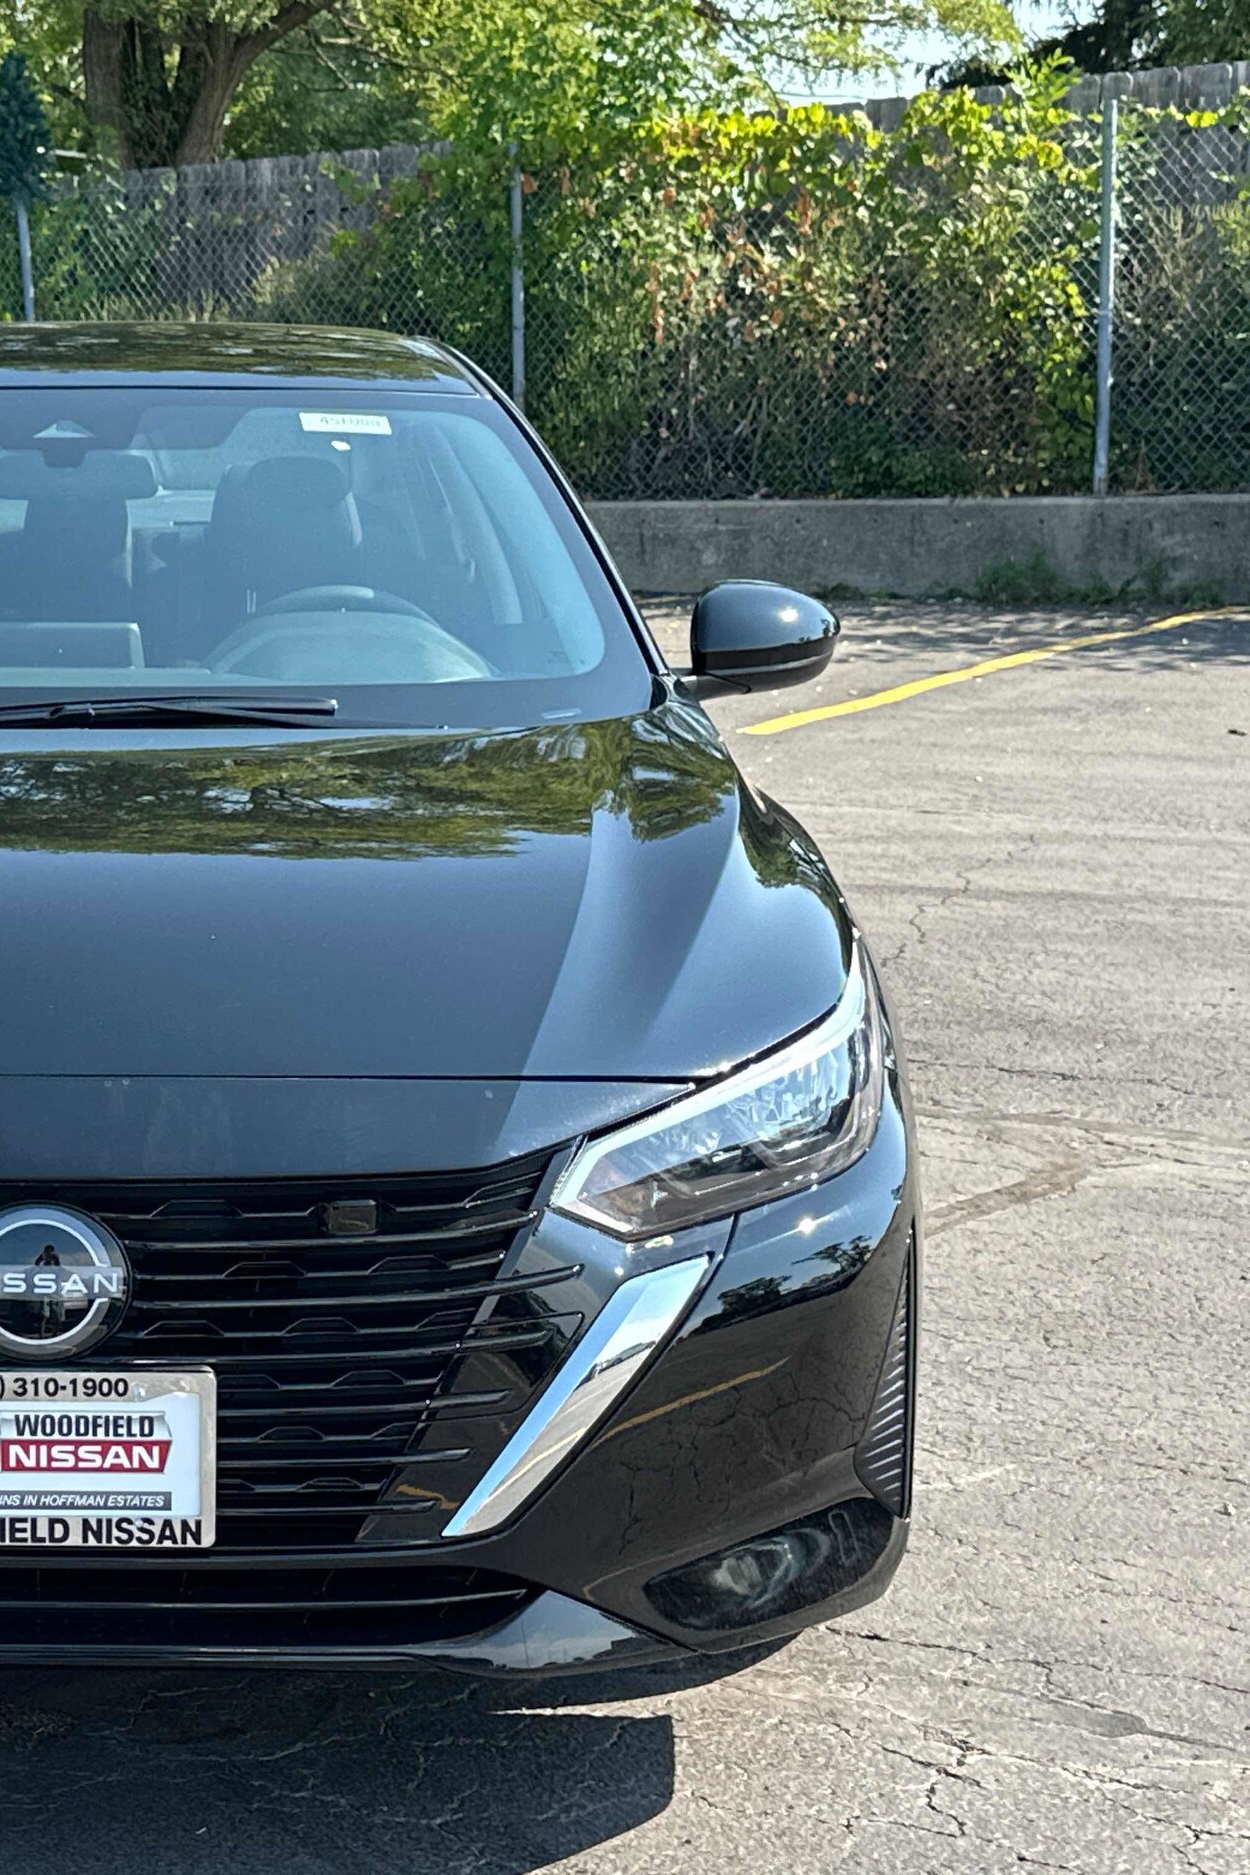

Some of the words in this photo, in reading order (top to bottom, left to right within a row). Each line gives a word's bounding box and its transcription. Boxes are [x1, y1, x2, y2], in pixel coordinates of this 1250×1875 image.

[12, 1377, 129, 1398] 310-1900
[14, 1413, 155, 1438] WOODFIELD
[8, 1444, 160, 1469] NISSAN
[22, 1495, 39, 1507] IN
[39, 1494, 105, 1507] HOFFMAN
[107, 1495, 165, 1507] ESTATES
[81, 1517, 202, 1546] NISSAN
